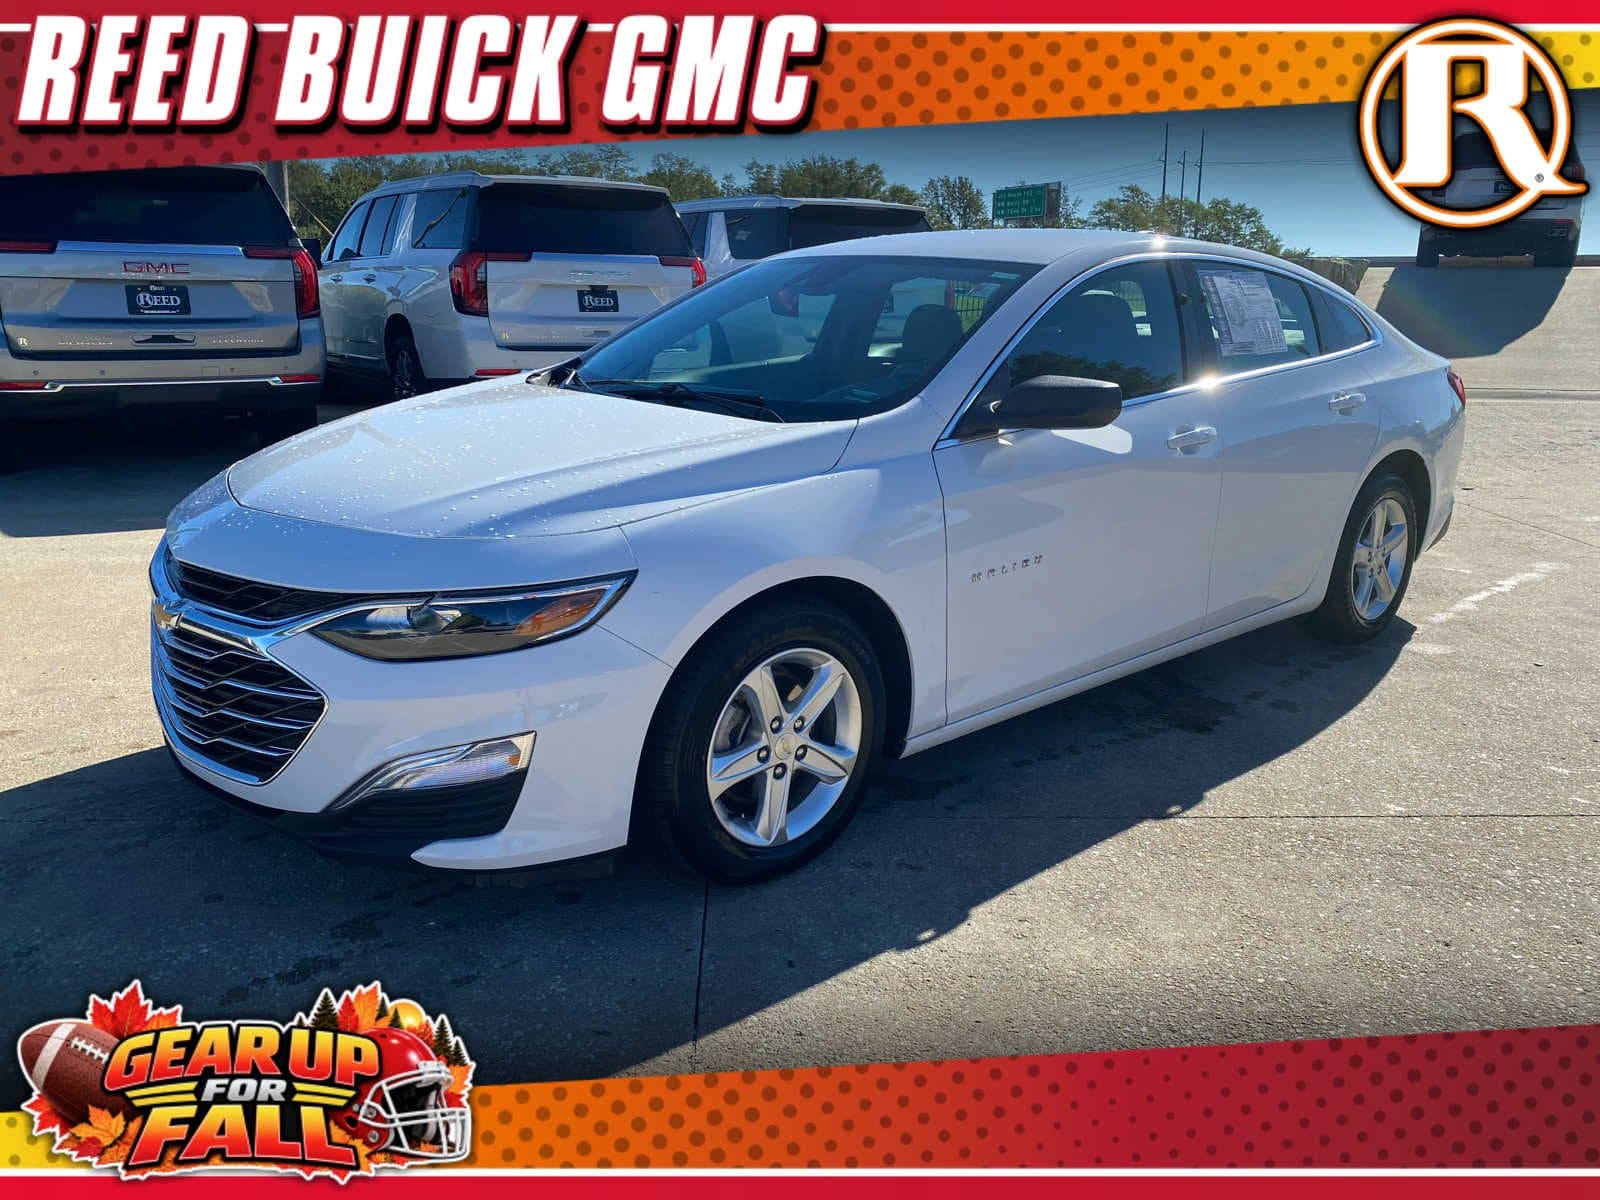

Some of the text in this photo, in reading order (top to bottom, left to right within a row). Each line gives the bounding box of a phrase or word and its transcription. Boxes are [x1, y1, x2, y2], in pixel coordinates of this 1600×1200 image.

[122, 261, 190, 274] GMC
[136, 293, 181, 309] REED
[583, 295, 614, 309] REED
